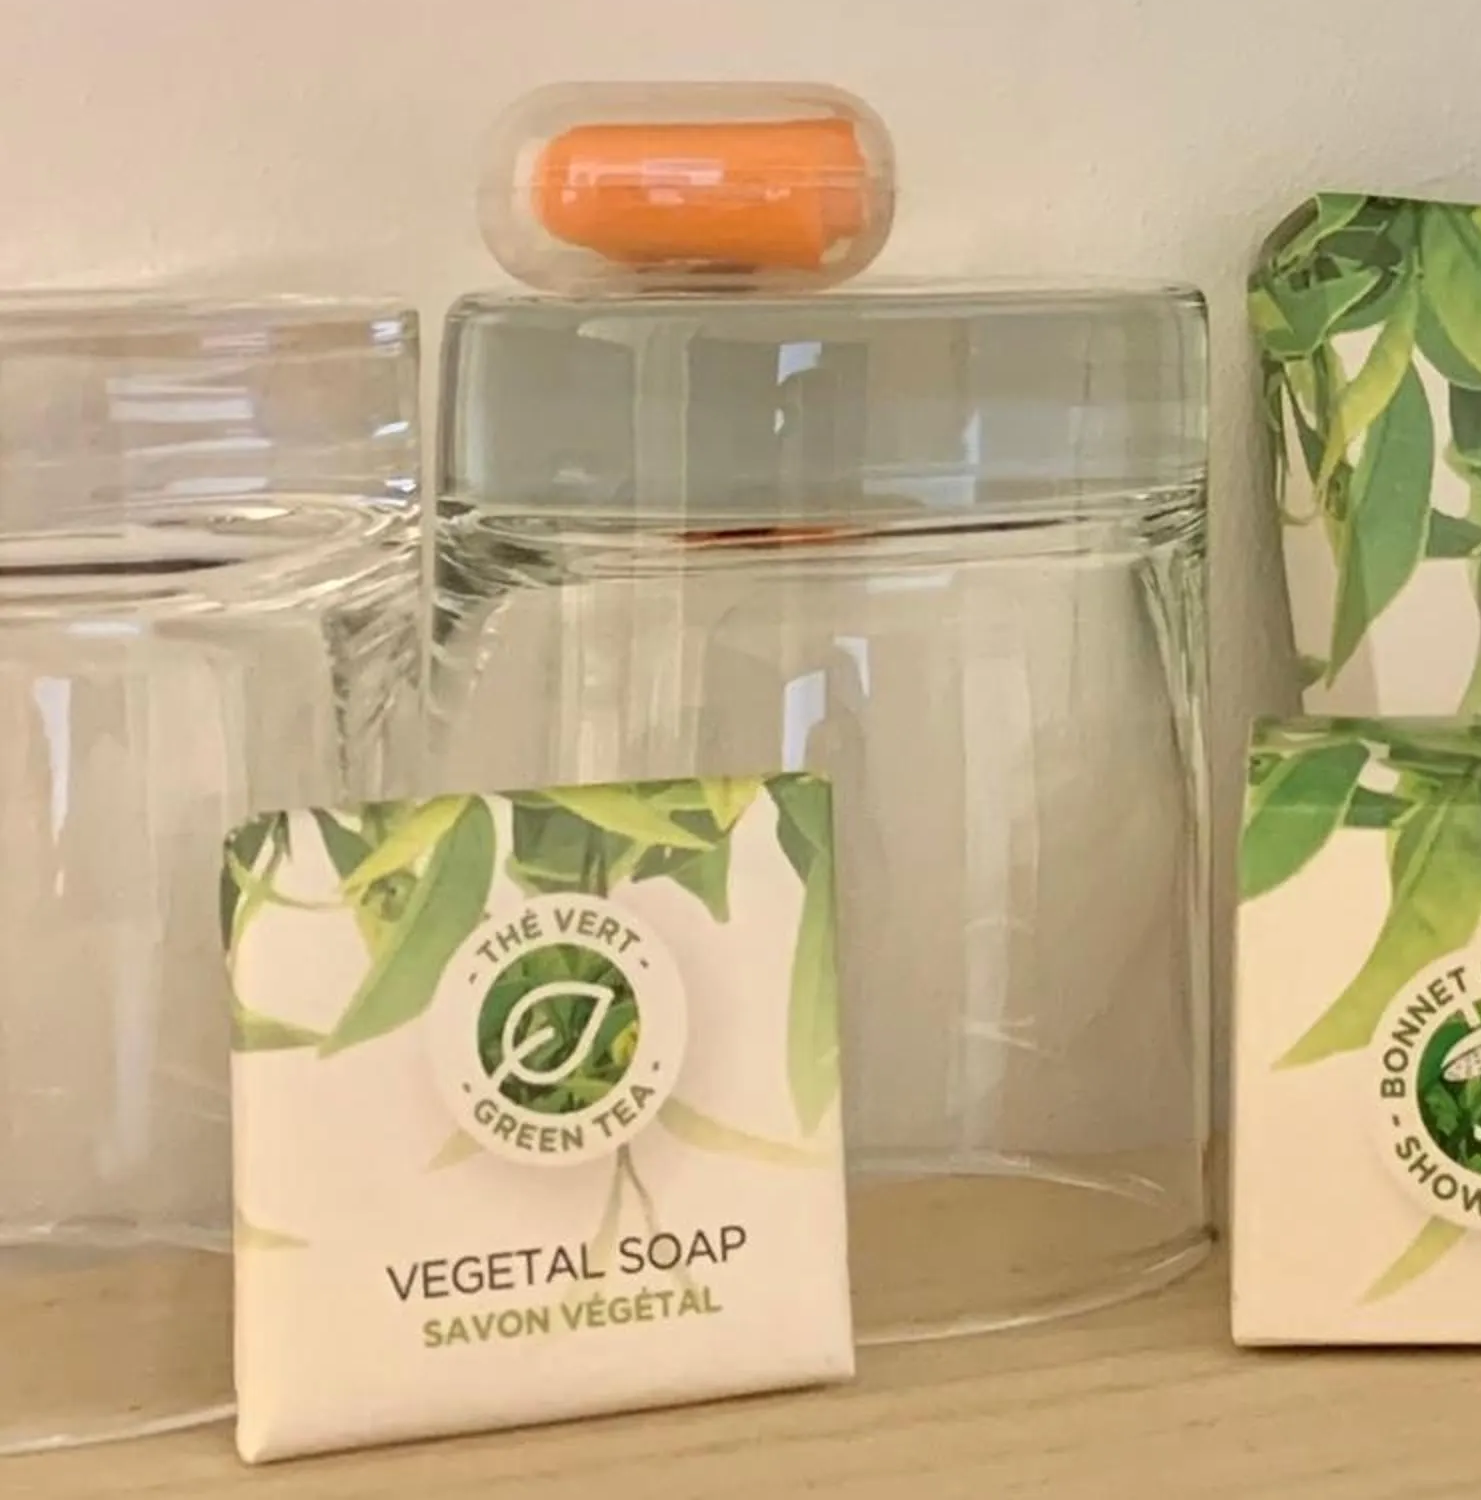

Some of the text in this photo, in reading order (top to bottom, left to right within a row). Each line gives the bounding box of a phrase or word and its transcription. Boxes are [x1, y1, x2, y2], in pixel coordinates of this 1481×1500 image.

[476, 908, 641, 963] THÉ VERT
[1380, 967, 1468, 1099] BONNET
[474, 1082, 656, 1153] GREEN TEA
[386, 1225, 747, 1301] VEGETAL SOAP
[423, 1285, 723, 1348] SAVON VÉGÉTAL
